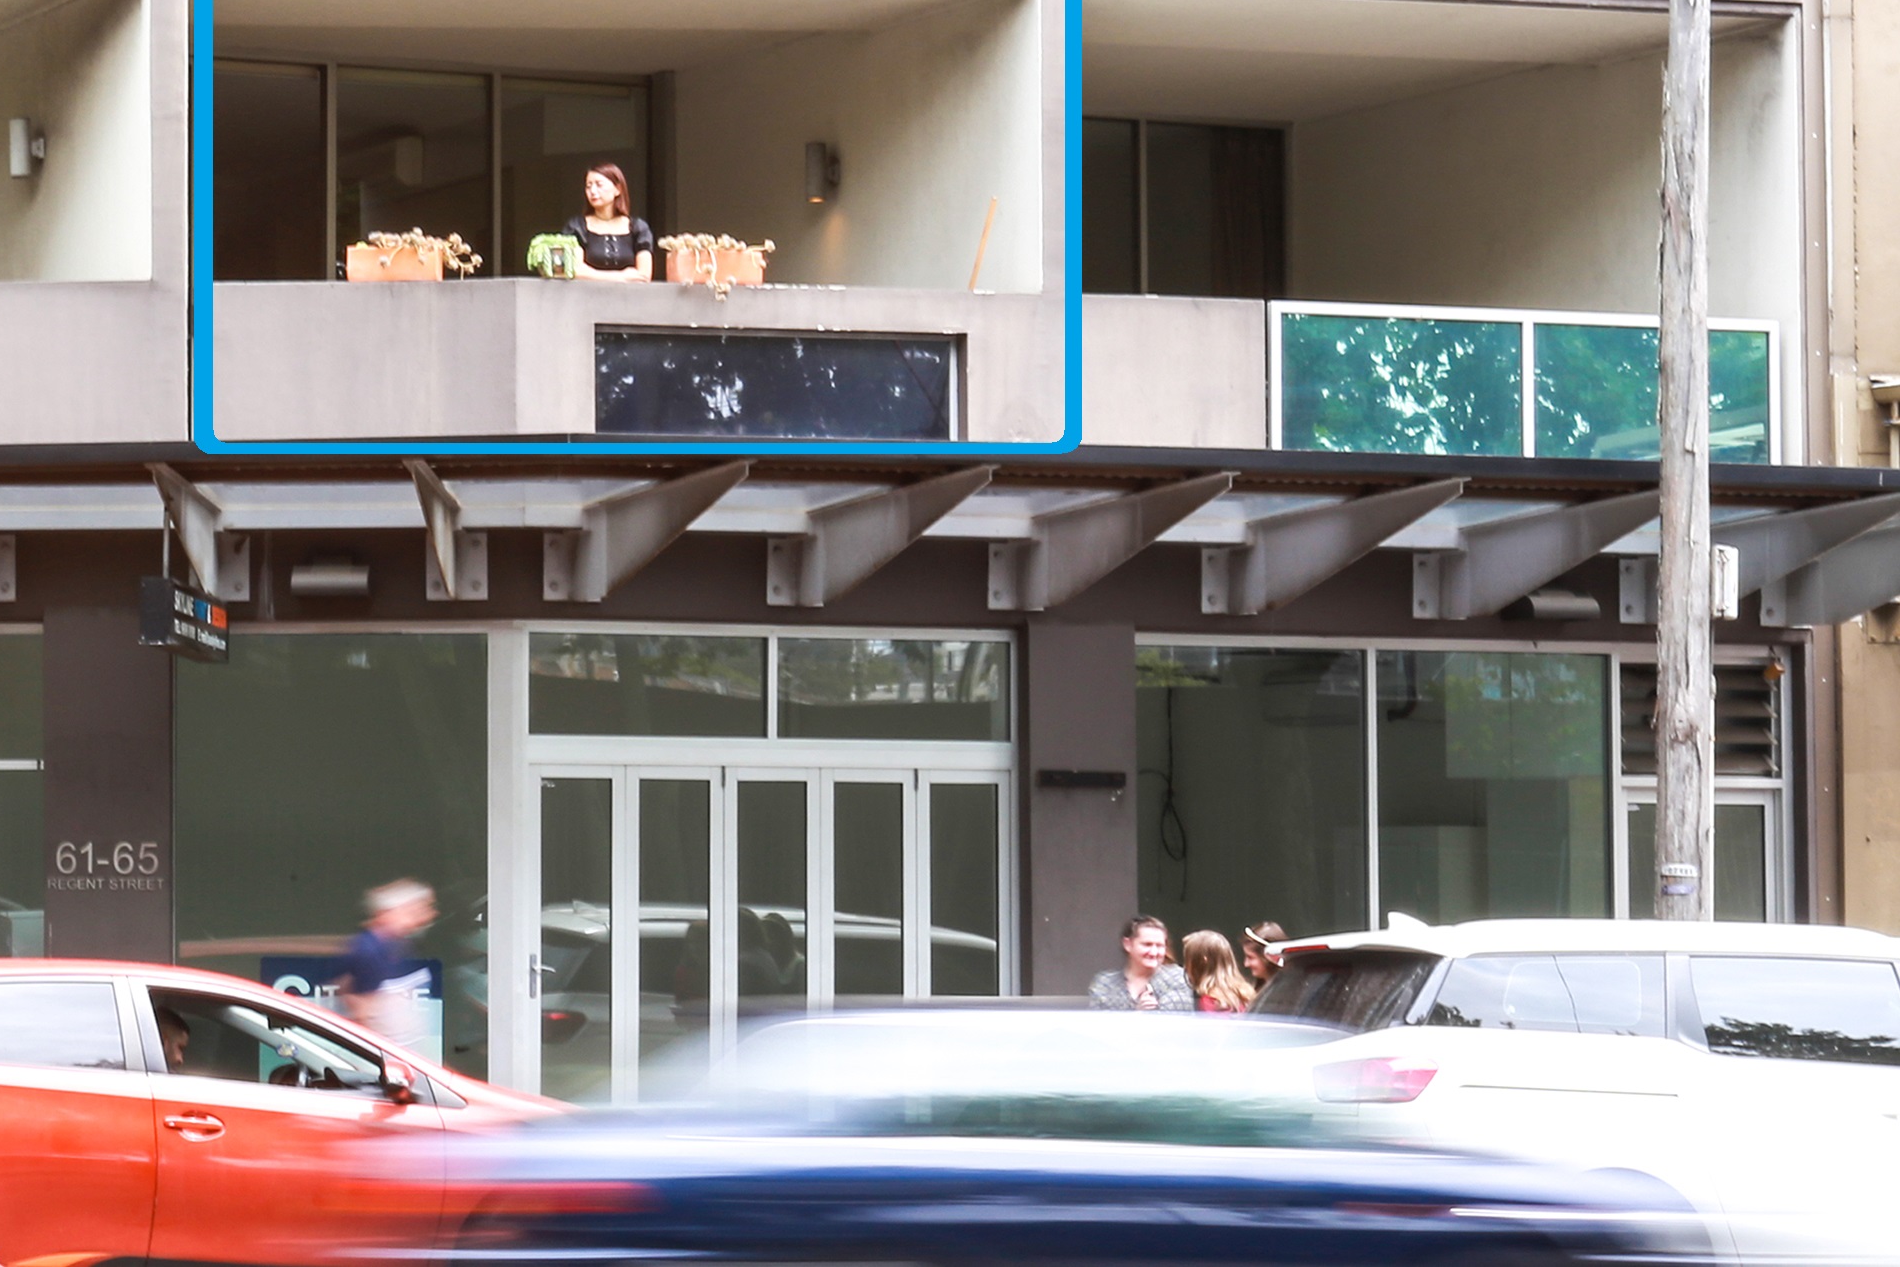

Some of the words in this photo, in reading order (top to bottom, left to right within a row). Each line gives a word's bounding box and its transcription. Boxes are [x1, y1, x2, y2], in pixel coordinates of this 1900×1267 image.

[56, 841, 159, 875] 61-65
[47, 878, 105, 891] REGENT
[109, 878, 165, 891] STREET
